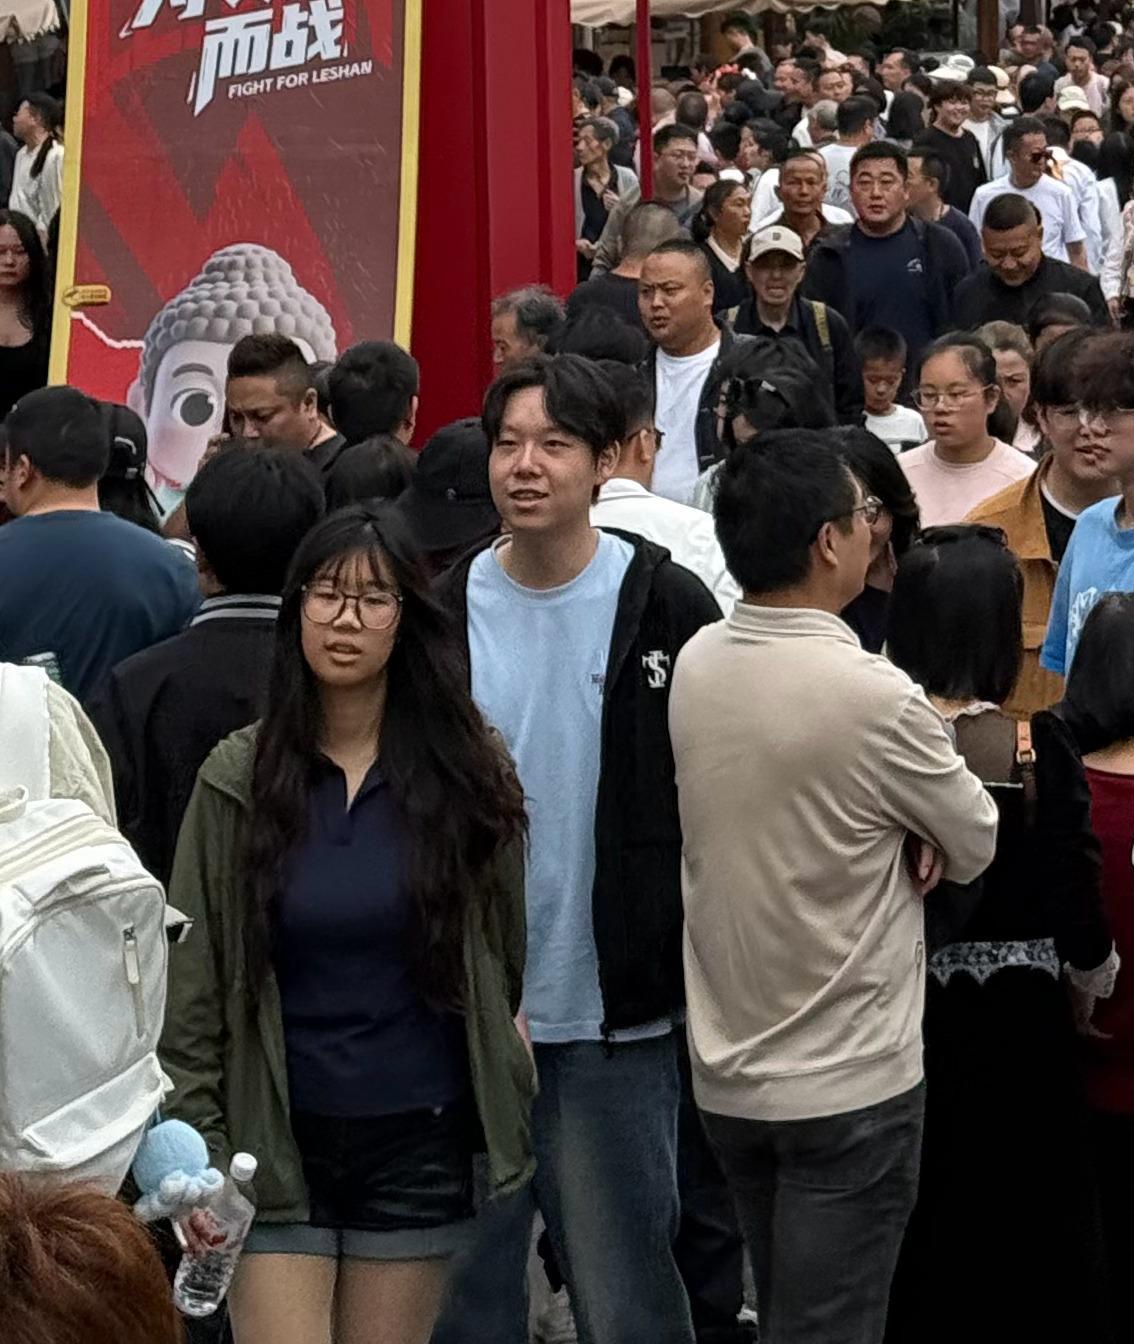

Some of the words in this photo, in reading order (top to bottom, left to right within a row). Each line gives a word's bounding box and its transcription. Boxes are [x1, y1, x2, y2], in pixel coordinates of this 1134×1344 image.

[227, 77, 275, 100] FIGHT
[275, 72, 309, 90] FOR
[311, 59, 373, 84] LESHAN
